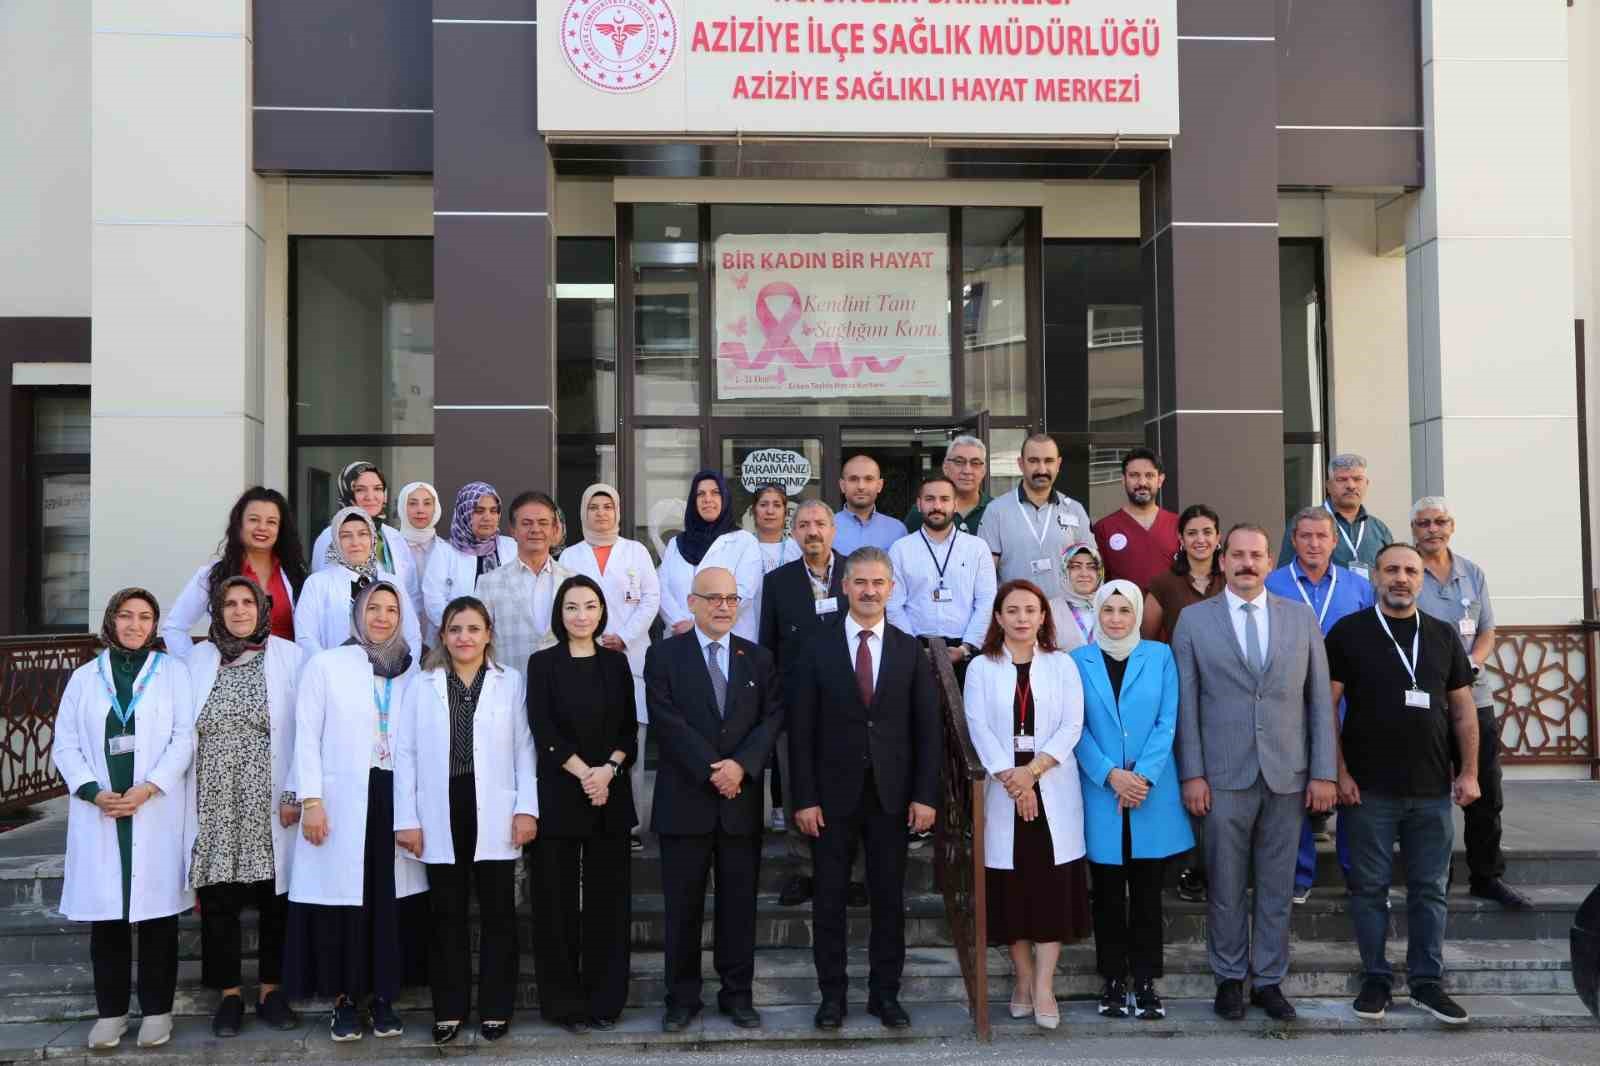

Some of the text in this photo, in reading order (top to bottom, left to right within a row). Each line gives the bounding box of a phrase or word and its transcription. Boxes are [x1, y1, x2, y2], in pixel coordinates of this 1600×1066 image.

[691, 16, 1160, 62] AZİZİYE İLÇE SAĞLIK MÜDÜRLÜĞÜ
[733, 70, 1141, 103] AZİZİYE SAĞLIKLI HAYAT MERKEZİ
[722, 249, 935, 270] BİR KADIN BİR HAYAT
[802, 294, 871, 313] Kendini
[752, 452, 796, 464] KANSER
[743, 463, 810, 475] TARAMANIZI
